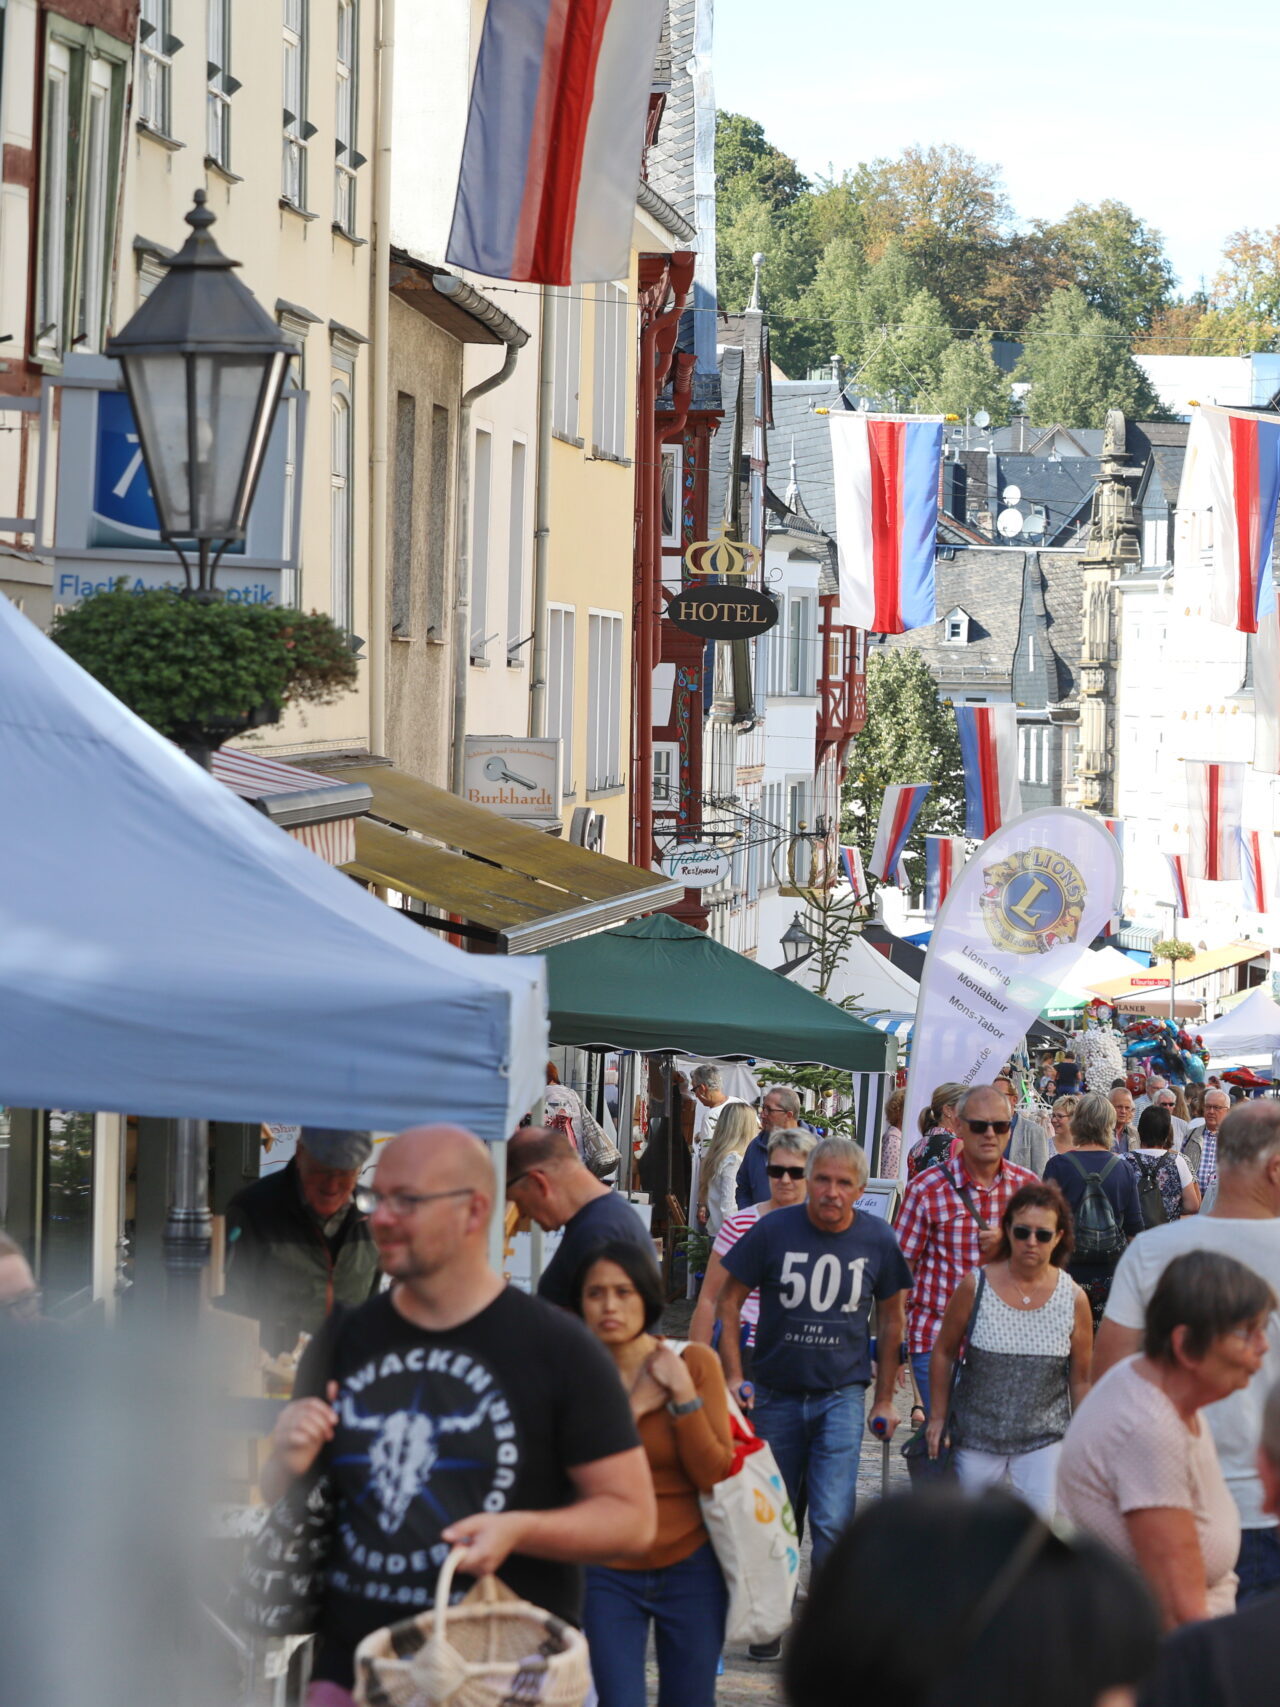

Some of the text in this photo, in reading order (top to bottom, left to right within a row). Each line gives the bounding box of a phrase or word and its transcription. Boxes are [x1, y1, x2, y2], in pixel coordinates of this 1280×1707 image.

[678, 601, 768, 624] HOTEL
[467, 787, 553, 805] Burkhardt
[1033, 852, 1081, 898] LIONS
[1010, 876, 1049, 927] L
[961, 945, 1011, 986] Lions Club
[957, 972, 1009, 1013] Montabaur
[948, 995, 1005, 1039] Mons-Tabor
[865, 1198, 877, 1207] des
[779, 1251, 865, 1313] 501
[784, 1333, 840, 1345] ORIGINAL
[803, 1324, 824, 1333] THE
[346, 1348, 494, 1393] WACKEN
[483, 1398, 519, 1513] OUDER
